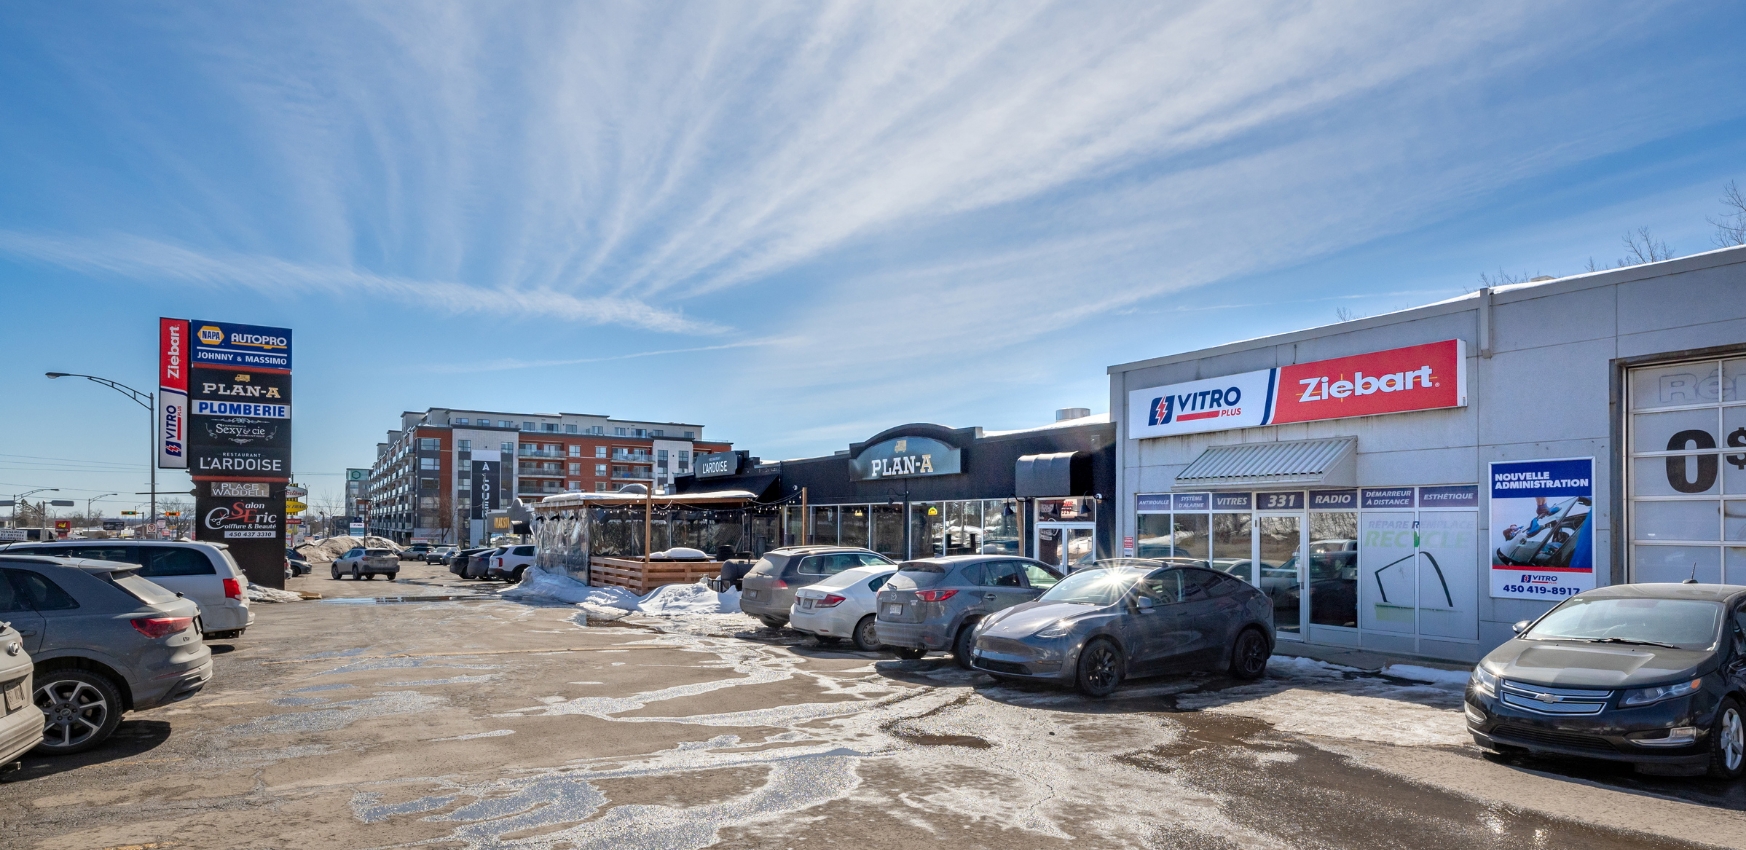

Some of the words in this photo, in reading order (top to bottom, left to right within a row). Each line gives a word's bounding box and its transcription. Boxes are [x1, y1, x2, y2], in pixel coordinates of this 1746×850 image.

[202, 330, 221, 340] NAPA
[231, 333, 287, 346] AUTOPRO
[167, 325, 180, 379] Ziebart
[197, 351, 233, 361] JOHNNY
[245, 355, 287, 365] MASSIMO
[202, 382, 281, 399] PLAN-A
[1298, 365, 1433, 403] Ziebart
[1177, 386, 1242, 412] VITRO
[198, 401, 285, 417] PLOMBERIE
[1220, 407, 1242, 417] PLUS
[165, 404, 177, 440] VITRO
[215, 423, 243, 437] Sexy
[251, 426, 265, 435] cie
[200, 457, 282, 472] L'ARDOISE
[702, 460, 728, 474] L'ARDOISE
[871, 454, 934, 477] PLAN-A
[1494, 471, 1550, 481] NOUVELLE
[1494, 479, 1589, 490] ADMINISTRATION
[212, 489, 268, 497] WADDELL
[1315, 494, 1351, 504] RADIO
[1365, 490, 1412, 498] DÉMARREUR
[1423, 492, 1474, 500] ESTHÉTIQUE
[1216, 496, 1248, 506] VITRES
[1267, 494, 1296, 508] 331
[1366, 498, 1373, 506] À
[1373, 498, 1410, 506] DISTANCE
[231, 501, 265, 518] Salon
[243, 508, 277, 524] Eric
[1368, 519, 1409, 529] RÉPARE
[1411, 520, 1474, 529] REMPLACE
[1364, 530, 1470, 548] RECYCLE
[1503, 584, 1525, 593] 450
[1527, 586, 1580, 596] 419-8917
